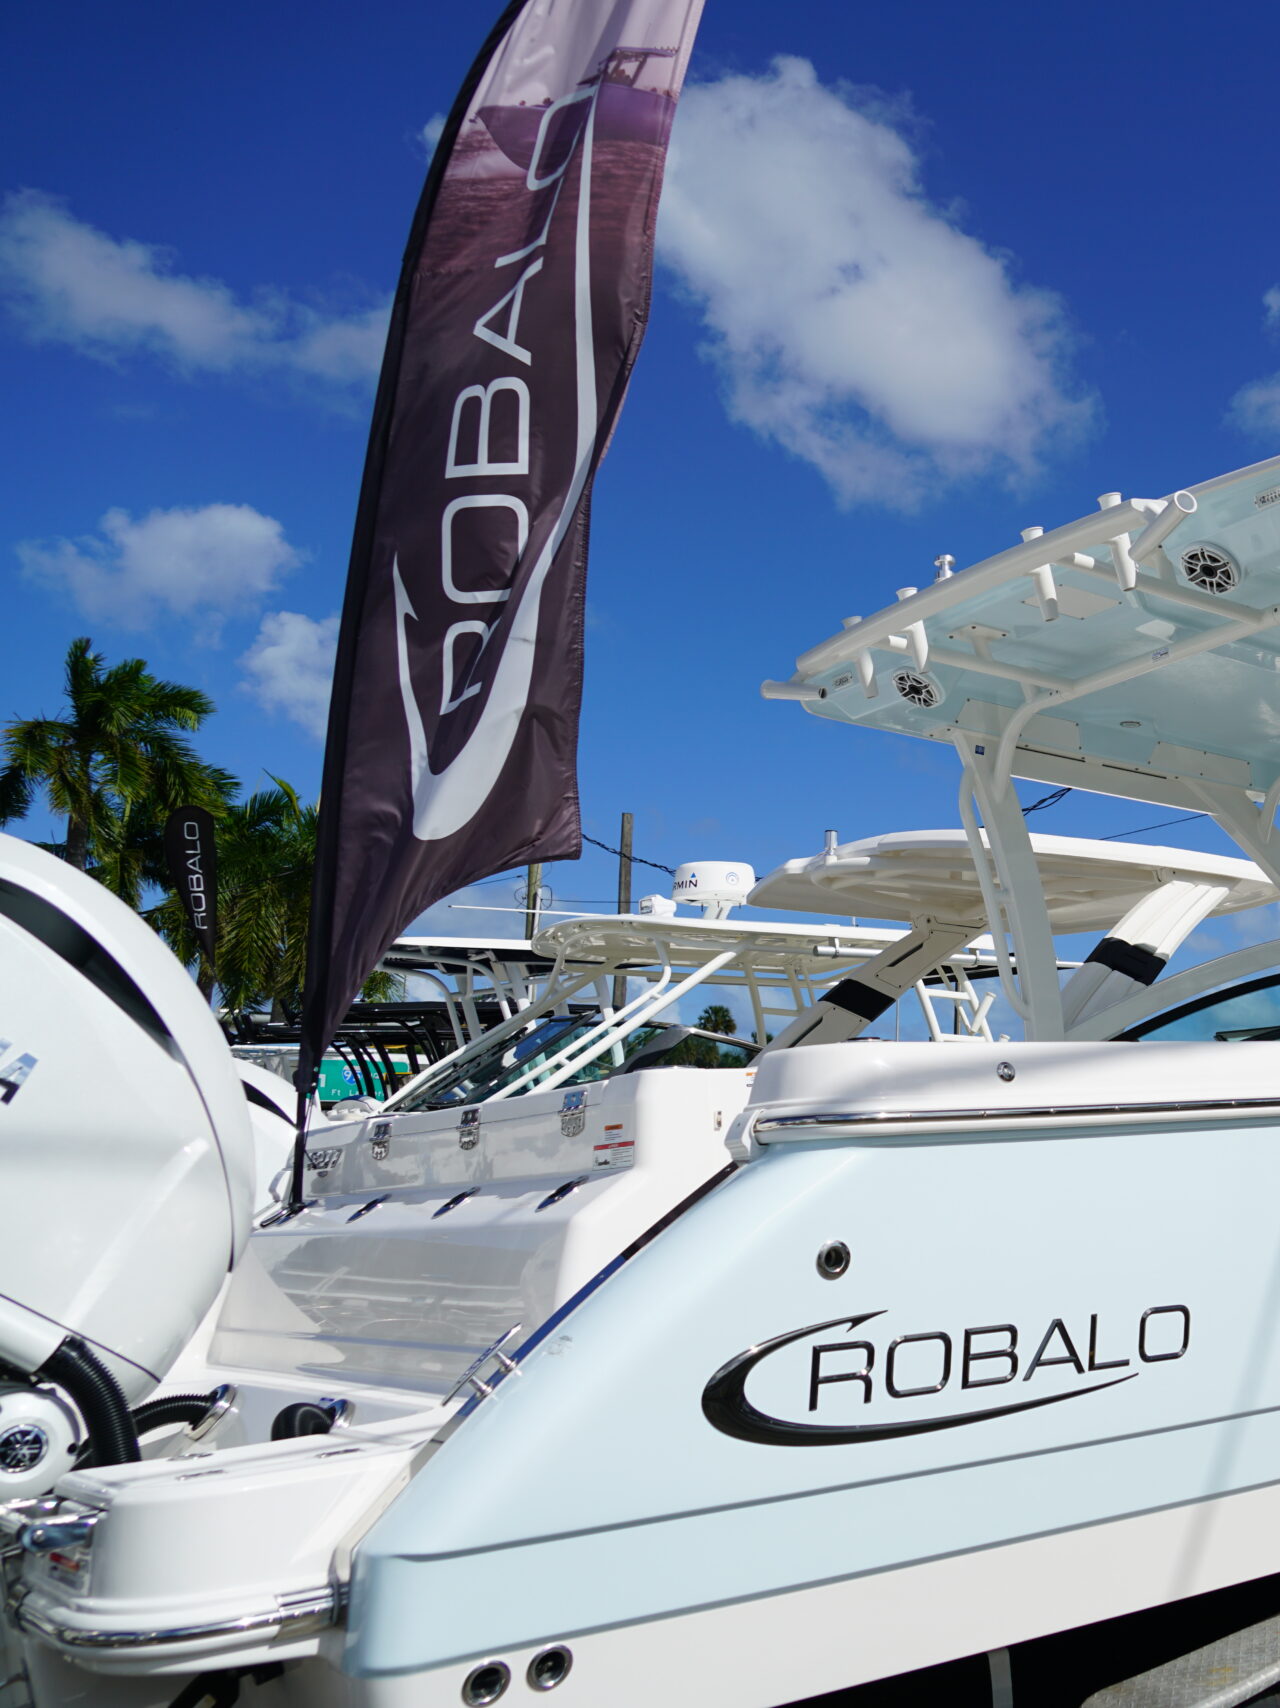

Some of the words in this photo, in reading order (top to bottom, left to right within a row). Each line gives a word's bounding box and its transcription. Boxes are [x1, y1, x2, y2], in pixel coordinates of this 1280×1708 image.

[439, 84, 598, 716] ROBALO
[184, 821, 208, 929] ROBALO
[331, 1088, 341, 1097] Ft
[808, 1304, 1191, 1412] ROBALO
